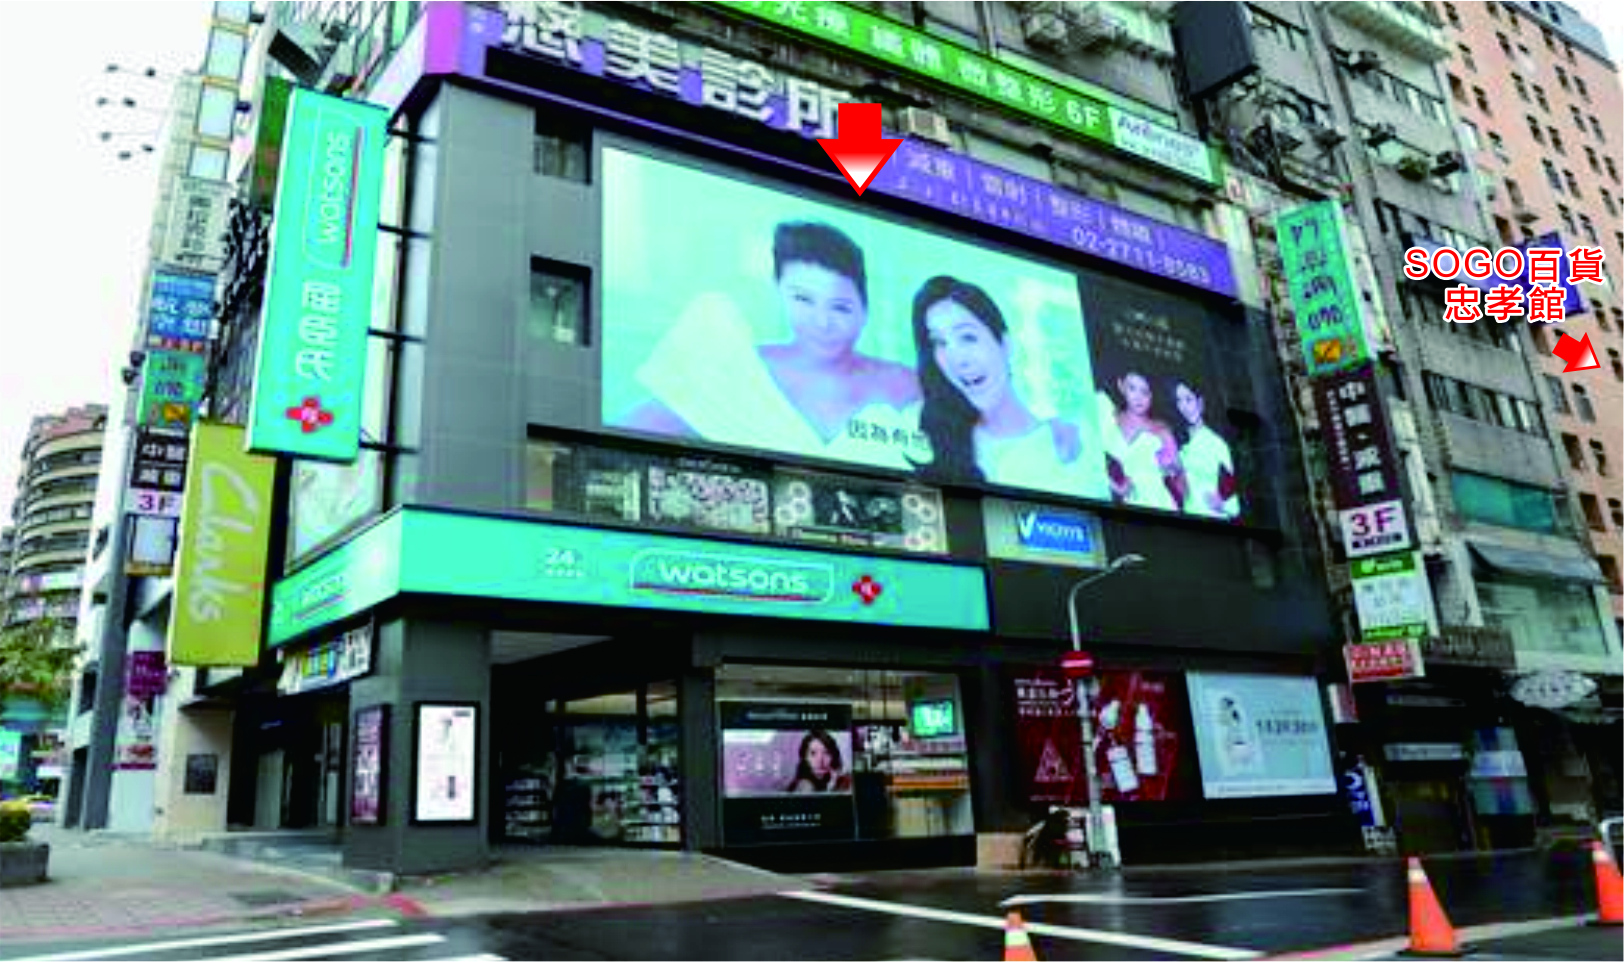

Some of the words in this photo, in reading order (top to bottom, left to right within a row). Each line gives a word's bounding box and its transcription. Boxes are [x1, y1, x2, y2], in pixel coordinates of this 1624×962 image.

[1066, 99, 1101, 127] 6F
[1351, 506, 1397, 536] 3F
[190, 463, 259, 623] Clarks
[658, 558, 808, 593] watsons
